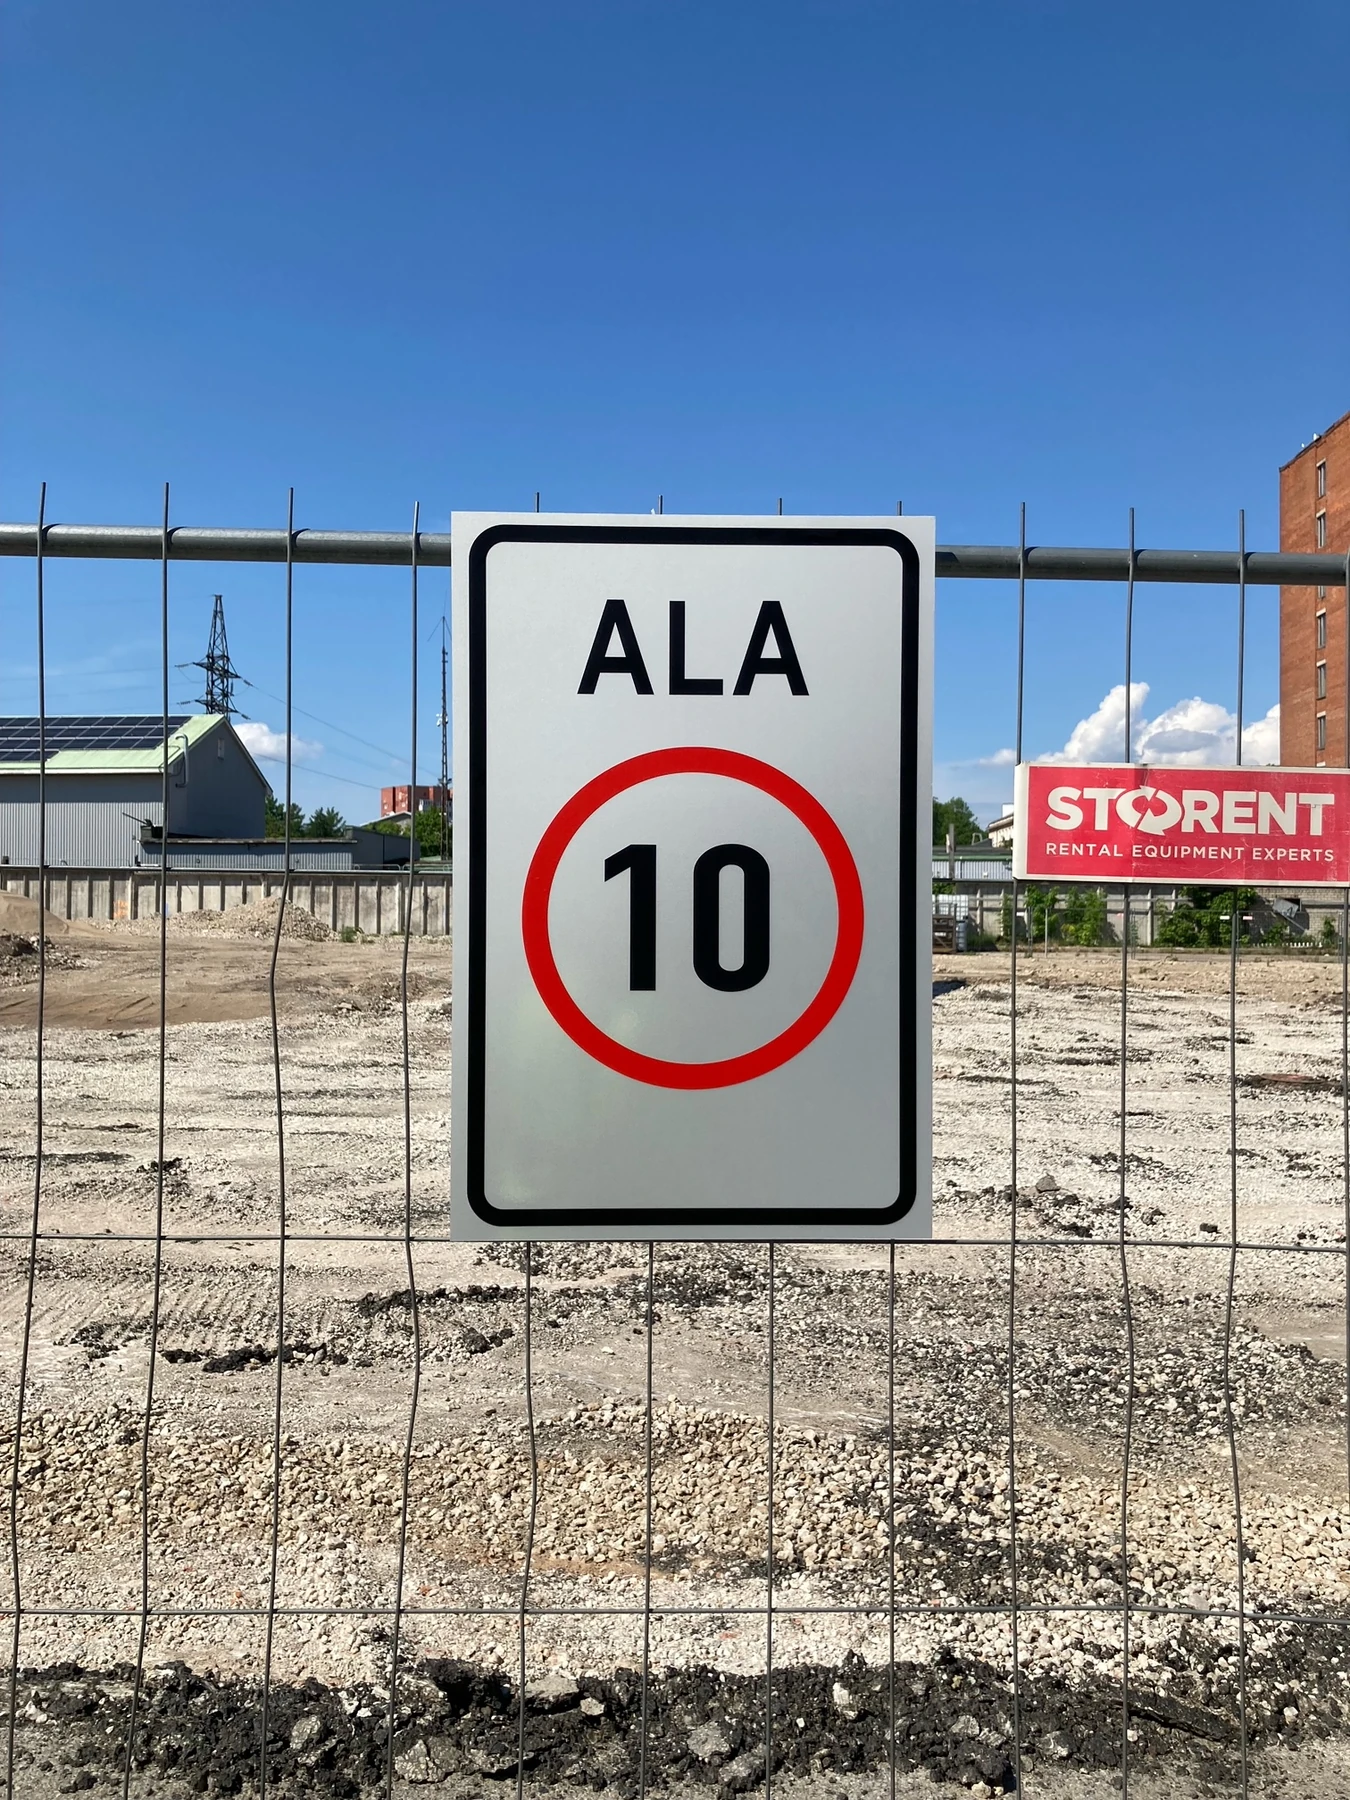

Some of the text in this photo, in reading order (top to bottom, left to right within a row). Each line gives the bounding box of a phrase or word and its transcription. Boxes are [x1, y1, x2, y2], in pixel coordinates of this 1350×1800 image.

[577, 599, 810, 696] ALA
[1045, 785, 1336, 836] STORENT
[1046, 842, 1335, 862] RENTAL EQUIPMENT EXPERTS
[604, 843, 771, 993] 10
